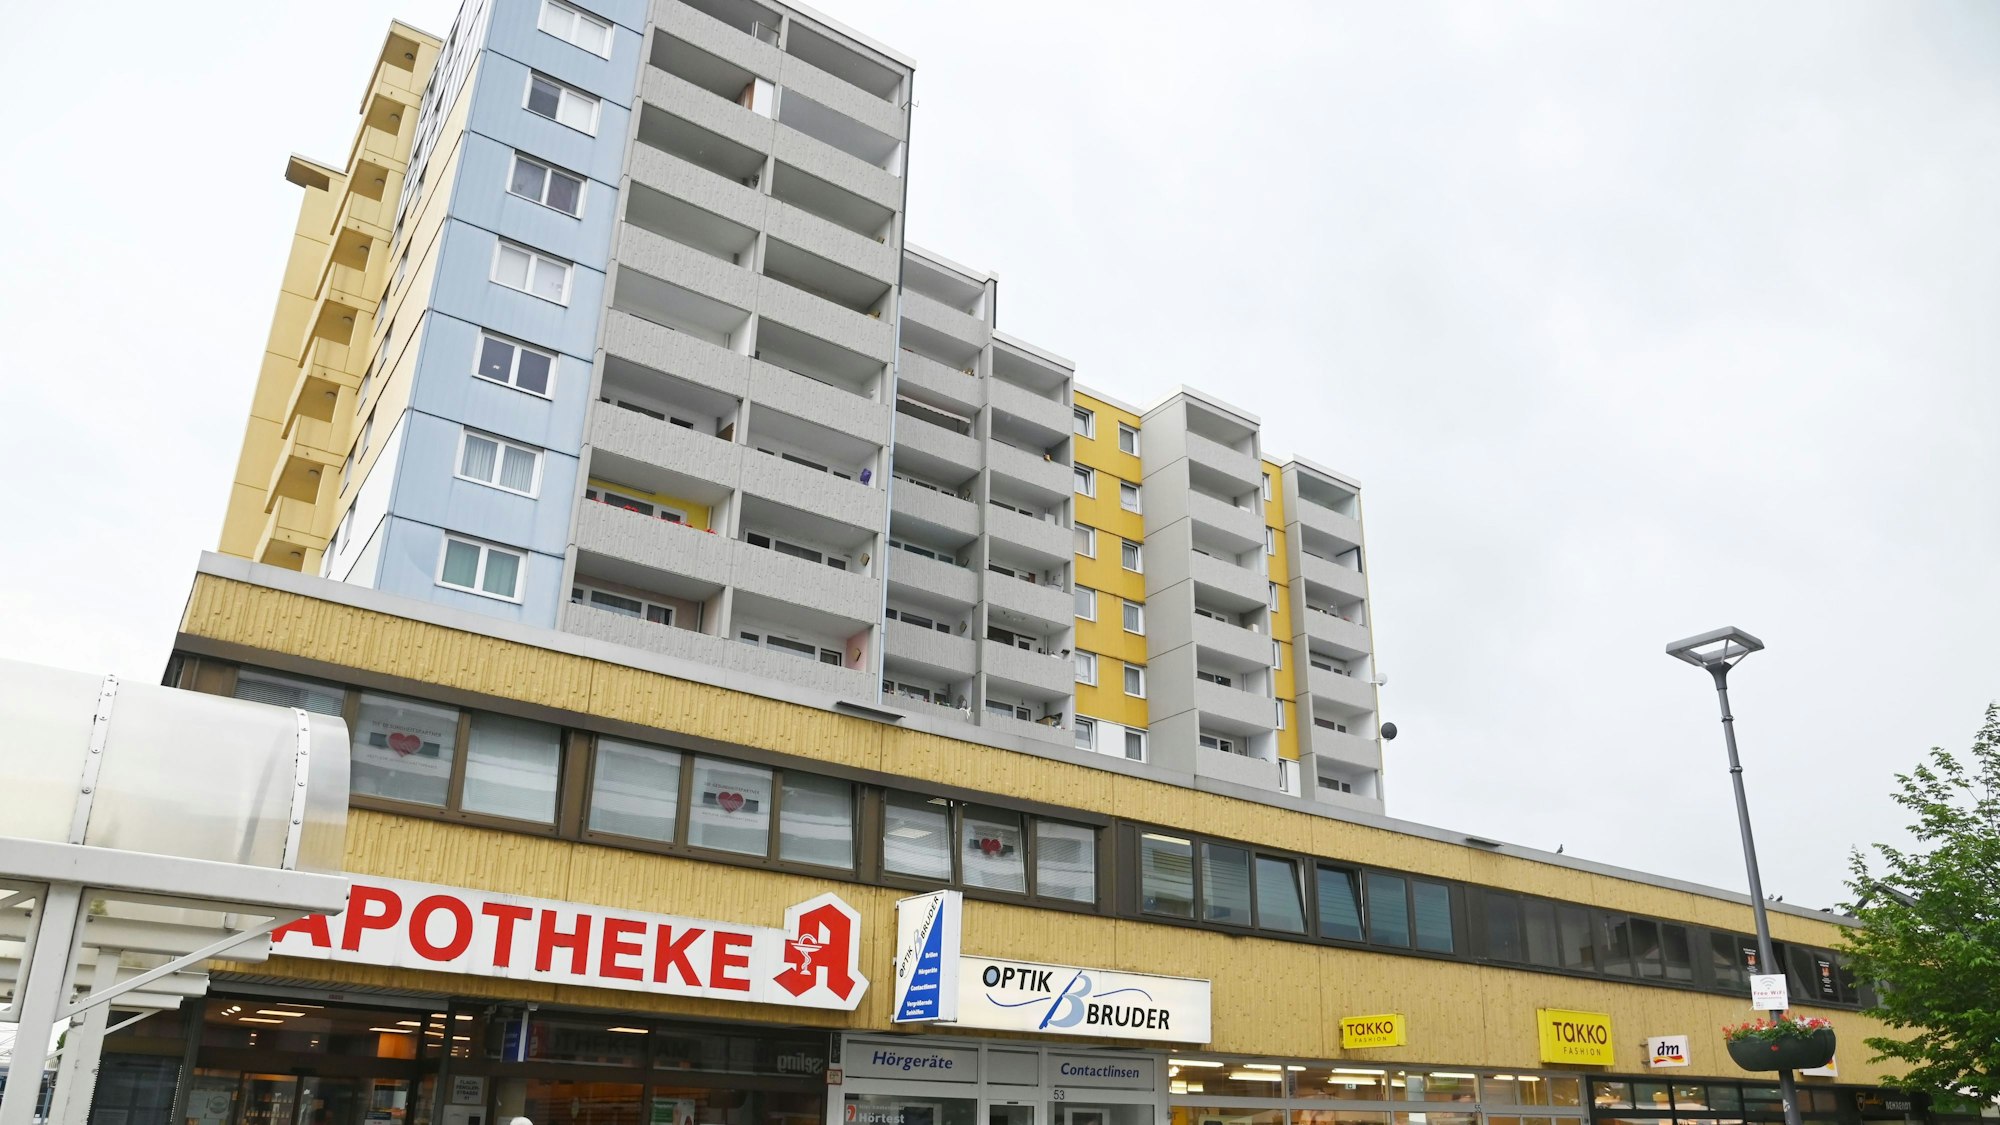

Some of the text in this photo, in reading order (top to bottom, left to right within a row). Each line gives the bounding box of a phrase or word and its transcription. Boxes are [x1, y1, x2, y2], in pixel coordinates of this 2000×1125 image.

[271, 885, 753, 992] APOTHEKE
[899, 945, 913, 978] OPTIK
[920, 896, 939, 939] BRUDER
[918, 967, 938, 977] Hörgeräte
[910, 984, 937, 992] Contactlinsen
[906, 999, 933, 1008] Vergrößernde
[983, 965, 1053, 993] OPTIK
[1086, 1003, 1170, 1031] BRUDER
[1354, 1036, 1388, 1044] FASHION
[1563, 1046, 1602, 1056] FASHION
[1656, 1041, 1680, 1058] dm
[872, 1051, 953, 1071] Hörgeräte
[1061, 1062, 1140, 1078] Contactlinsen
[1053, 1089, 1065, 1100] 53
[1474, 1104, 1482, 1113] 55
[859, 1112, 905, 1124] Hörtest
